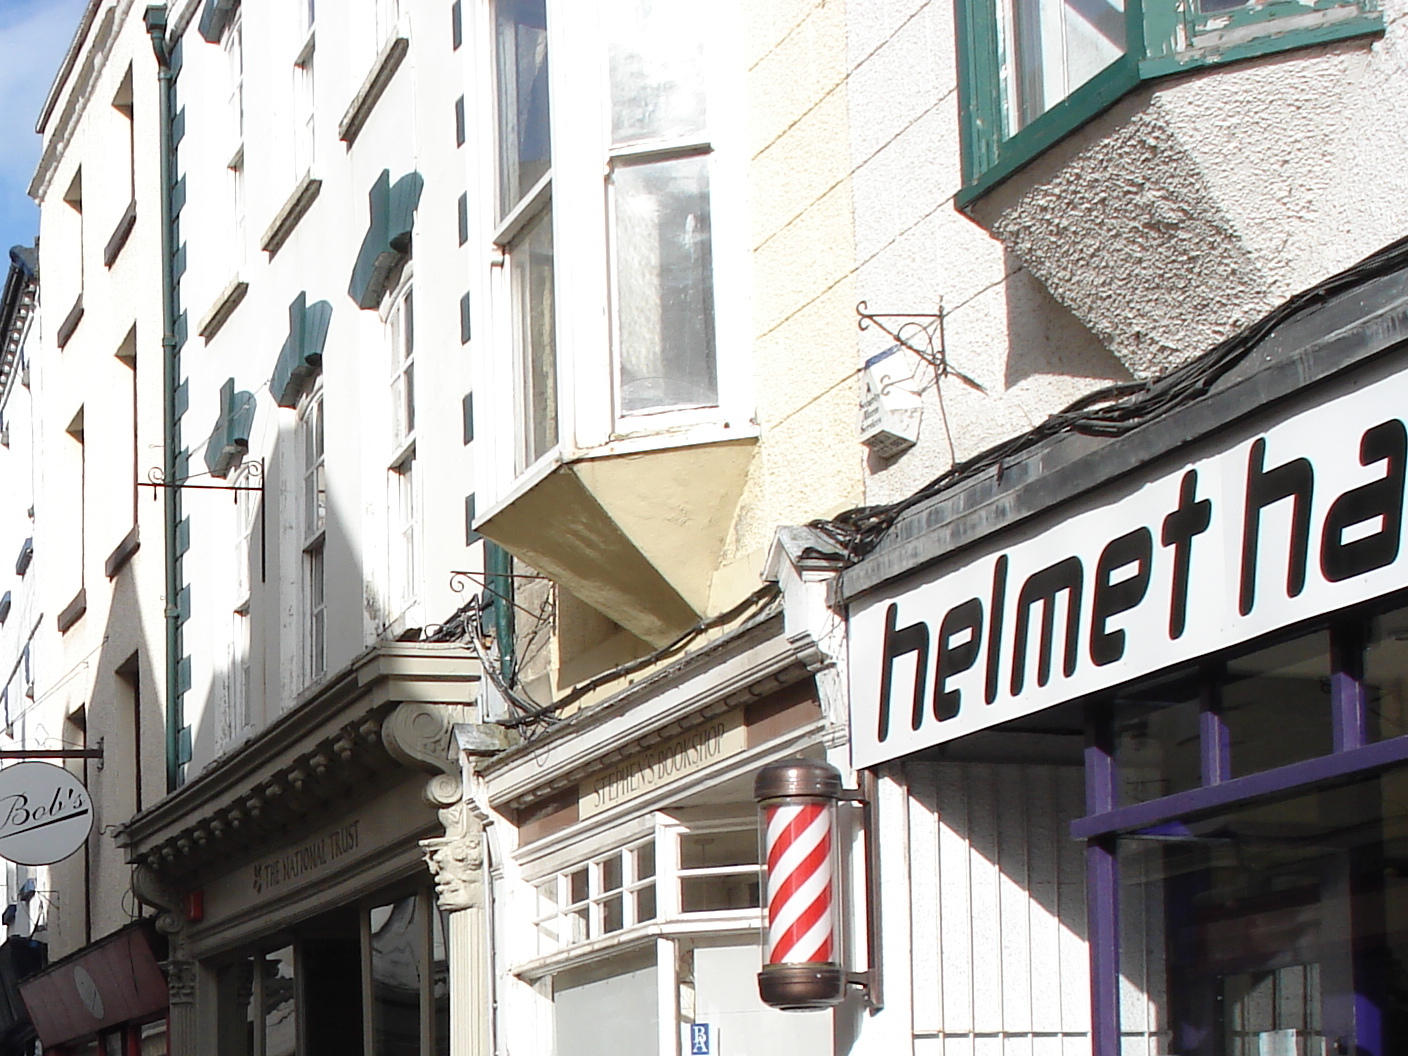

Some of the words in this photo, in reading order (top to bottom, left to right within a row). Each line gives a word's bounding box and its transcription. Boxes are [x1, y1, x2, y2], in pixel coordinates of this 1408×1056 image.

[877, 468, 1213, 744] helmet
[1237, 418, 1408, 617] ha
[593, 752, 655, 808] STEPHEN'S
[657, 722, 725, 780] BOOKSHOP
[264, 861, 280, 889] THE
[282, 838, 327, 881] NATIONAL
[329, 819, 361, 860] TRUST
